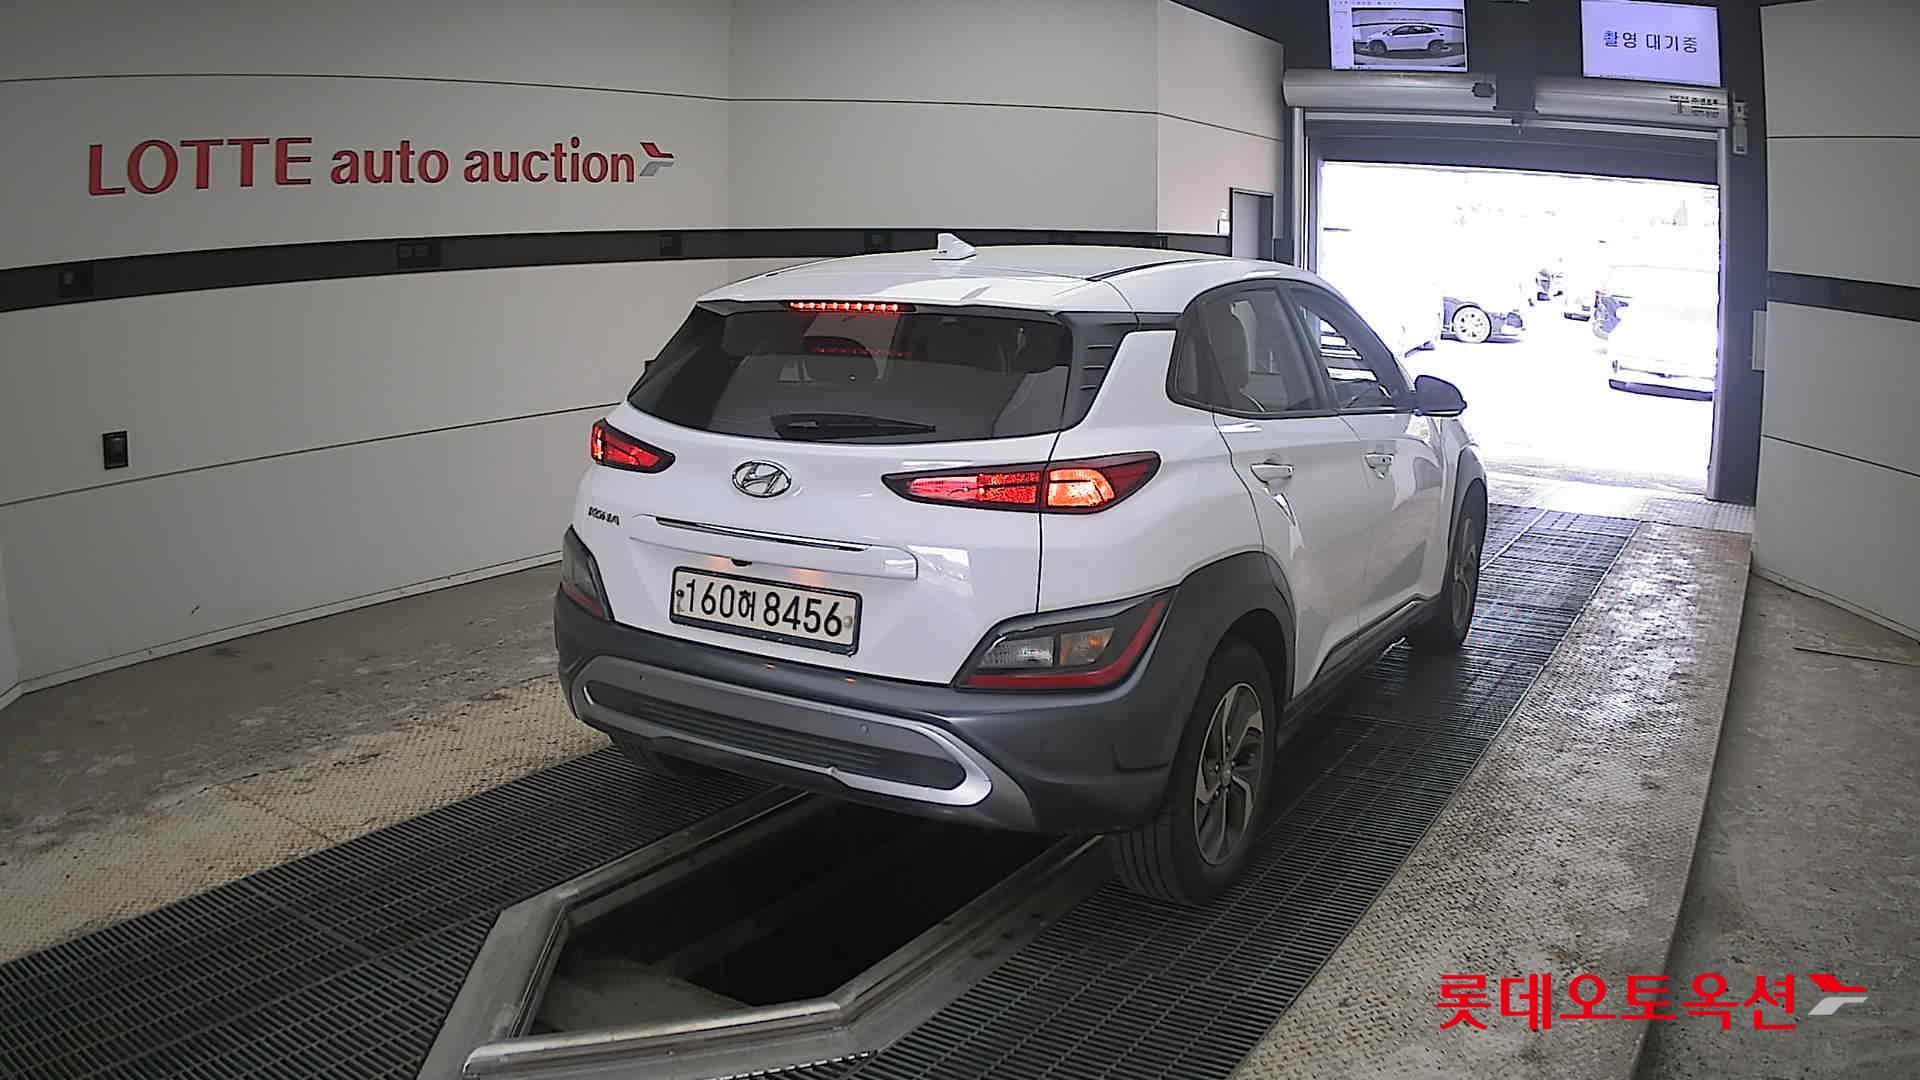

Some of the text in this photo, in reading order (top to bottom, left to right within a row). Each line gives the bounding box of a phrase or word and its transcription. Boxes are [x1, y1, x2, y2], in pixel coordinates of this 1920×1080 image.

[1603, 30, 1697, 54] 촬영 대기중
[88, 137, 635, 196] LOTTE auto auction
